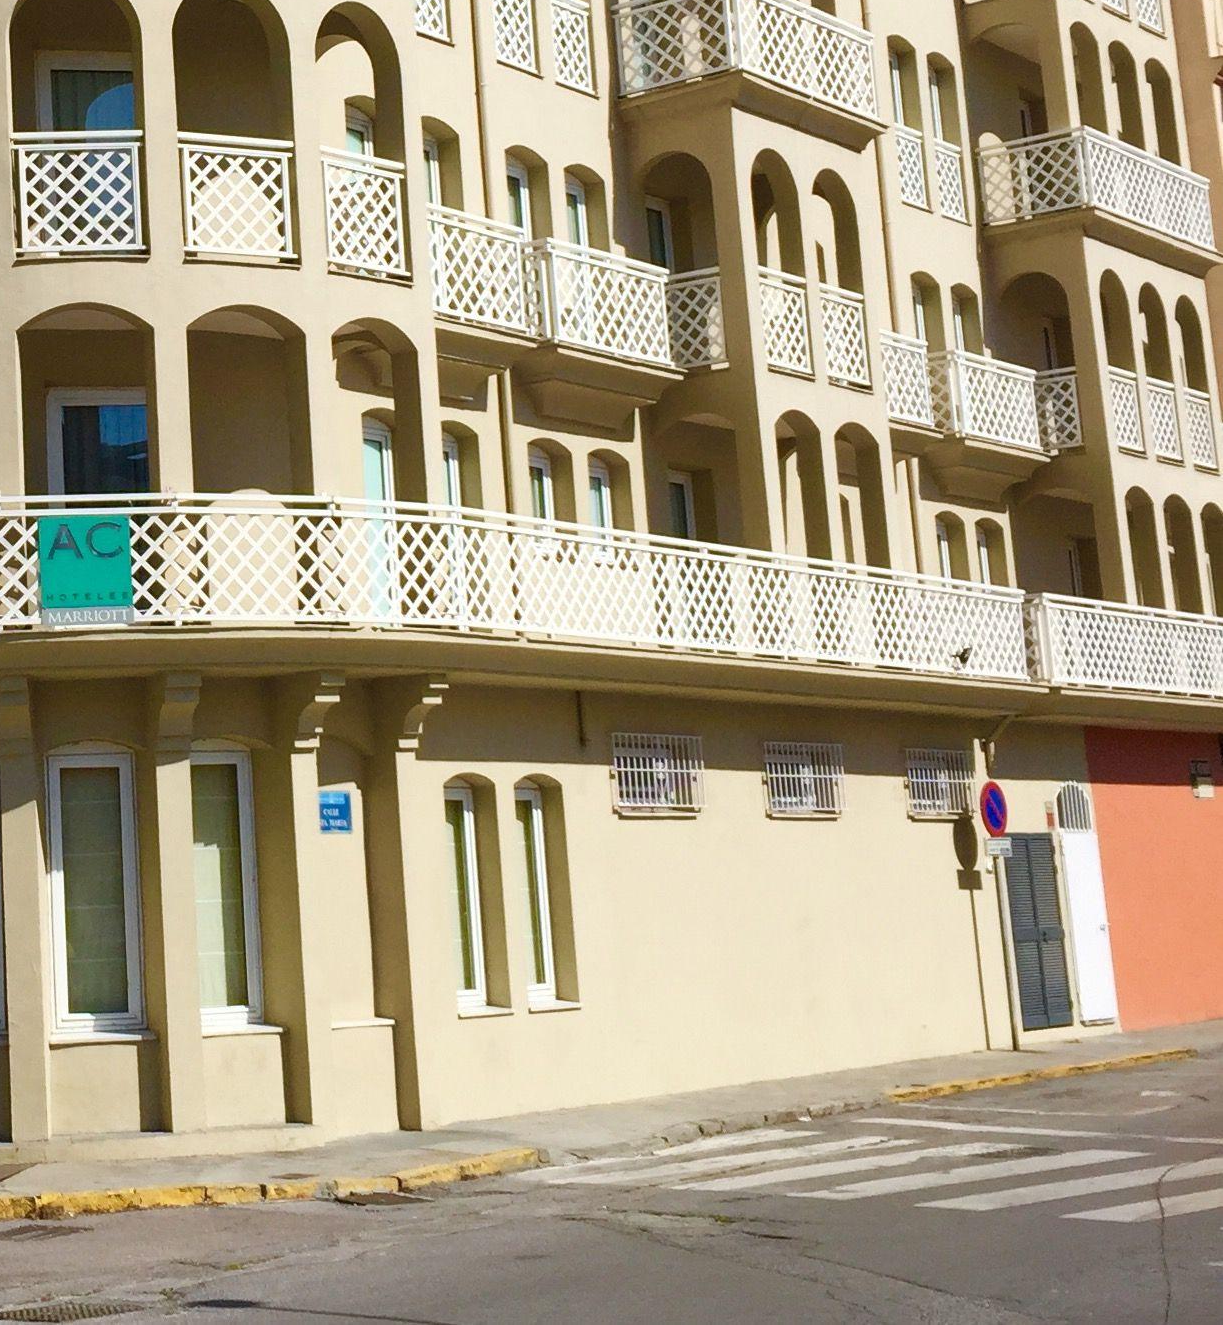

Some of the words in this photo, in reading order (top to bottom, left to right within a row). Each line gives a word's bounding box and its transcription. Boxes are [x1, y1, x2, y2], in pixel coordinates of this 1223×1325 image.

[47, 522, 124, 560] AC
[46, 591, 129, 602] HOTELES
[48, 609, 129, 624] MARRIOTT
